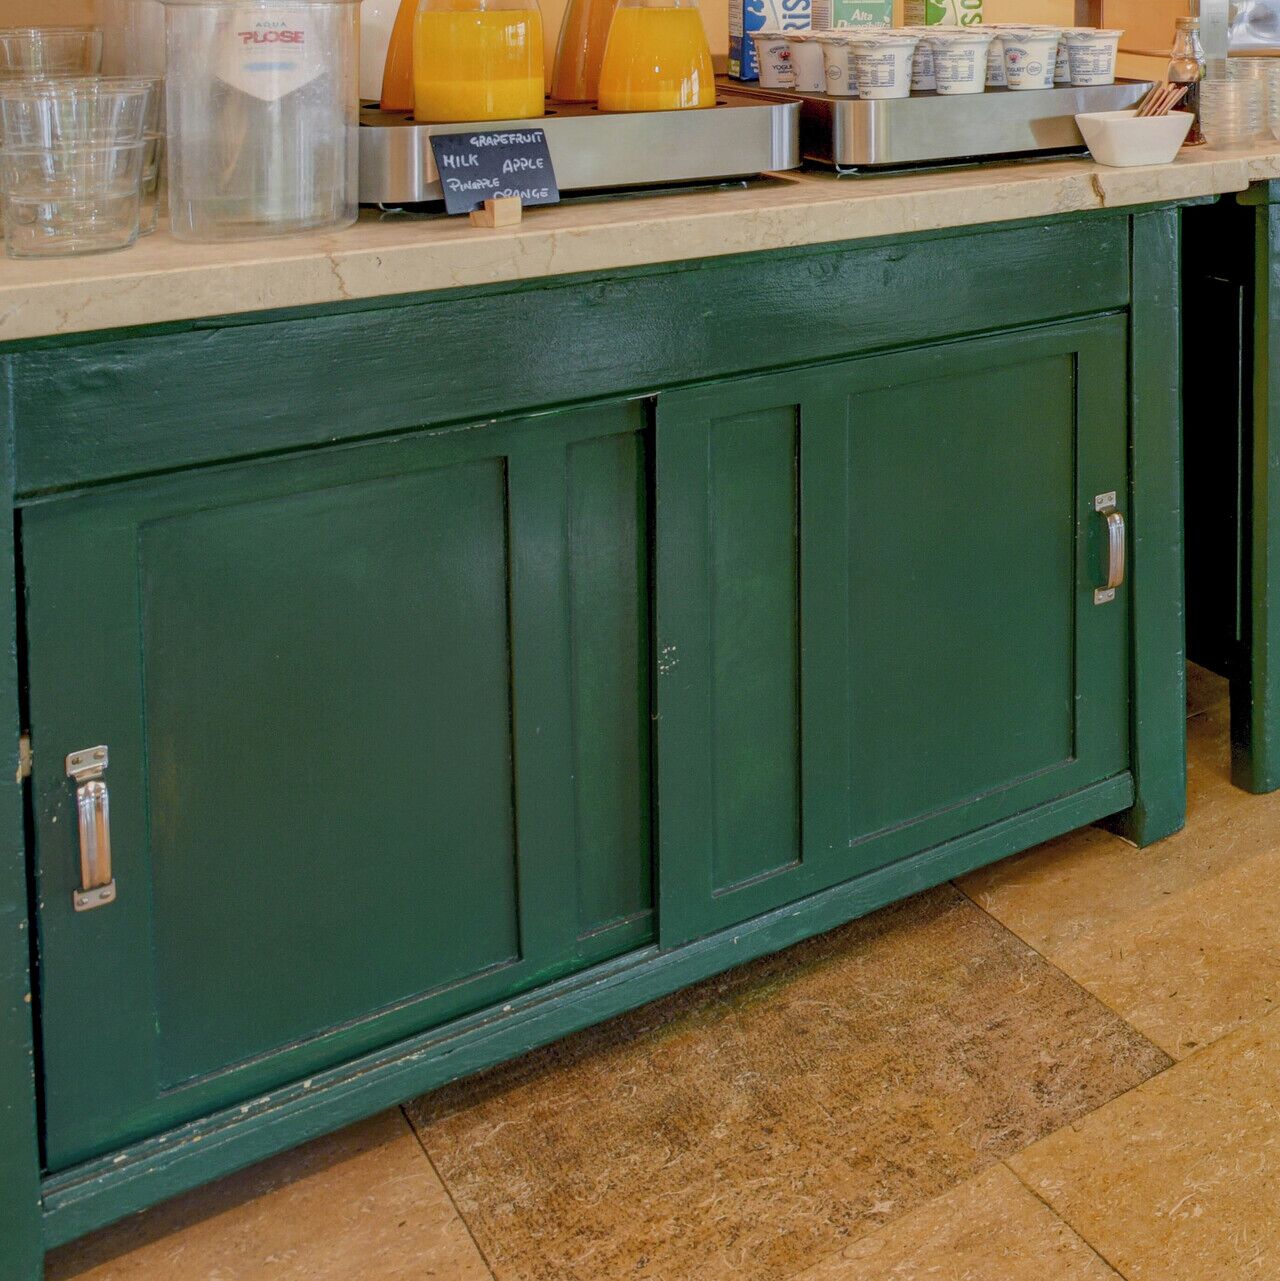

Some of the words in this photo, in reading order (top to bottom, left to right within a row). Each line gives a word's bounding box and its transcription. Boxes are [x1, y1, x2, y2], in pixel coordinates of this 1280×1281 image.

[851, 9, 873, 21] Alta
[238, 30, 305, 45] PLOSE
[469, 131, 543, 148] GRAPEFRUIT
[442, 154, 479, 169] MILK
[502, 158, 544, 174] APPLE
